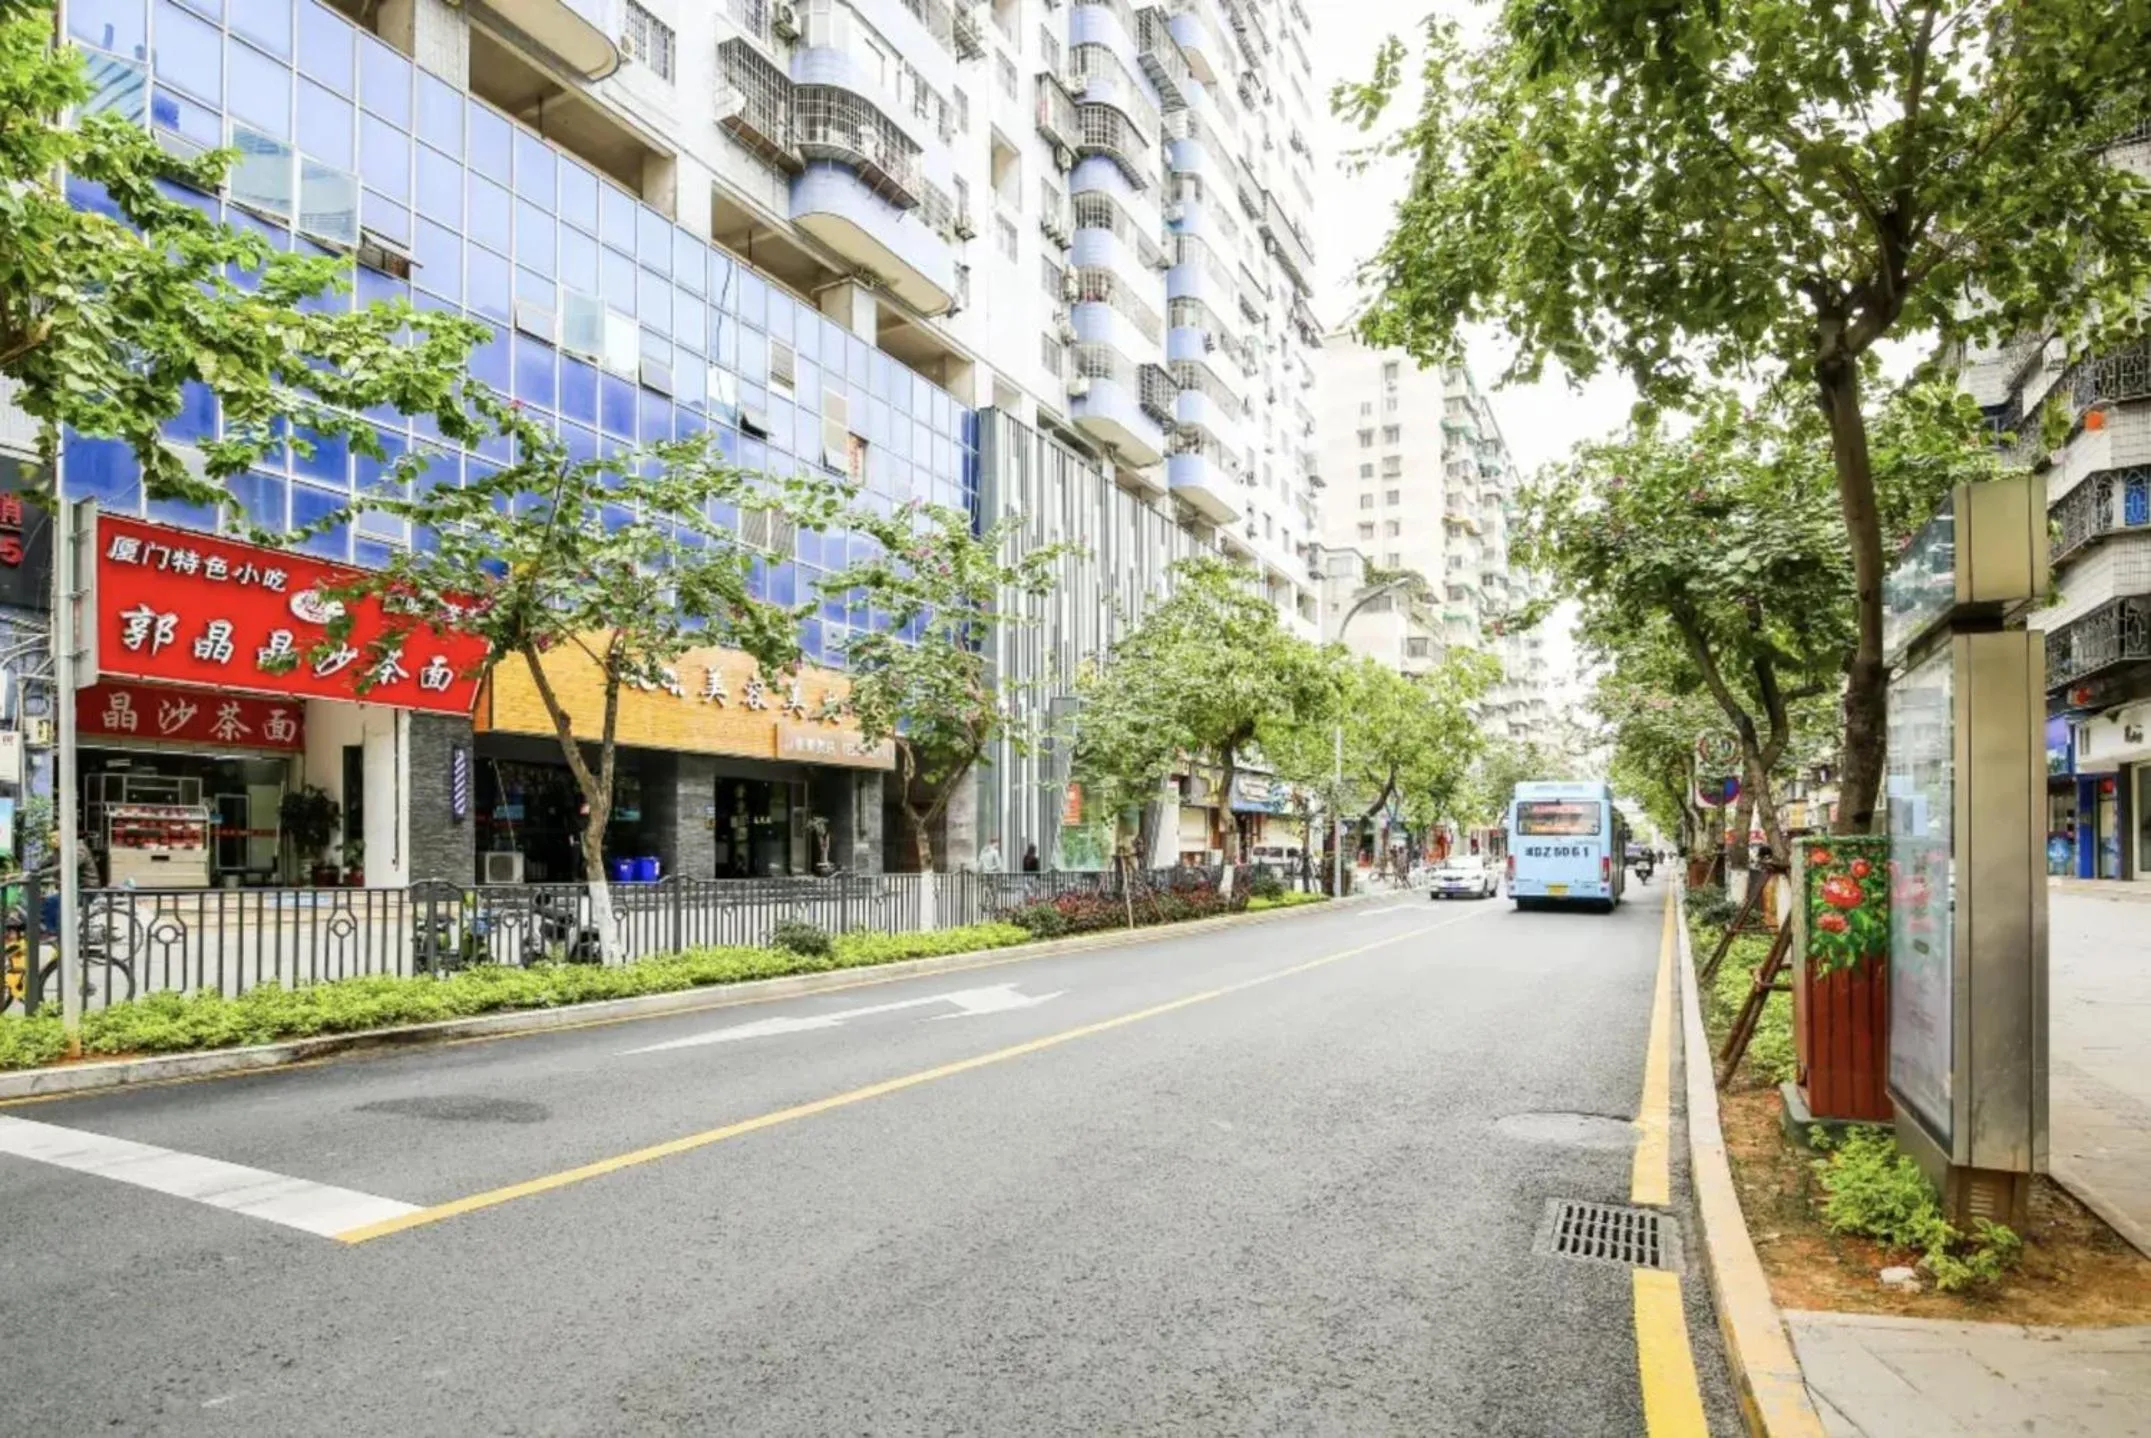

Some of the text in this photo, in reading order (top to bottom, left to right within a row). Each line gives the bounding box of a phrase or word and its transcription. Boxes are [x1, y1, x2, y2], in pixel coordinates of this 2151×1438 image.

[106, 534, 288, 592] 厦门特色小吃
[101, 691, 297, 743] 晶沙茶面
